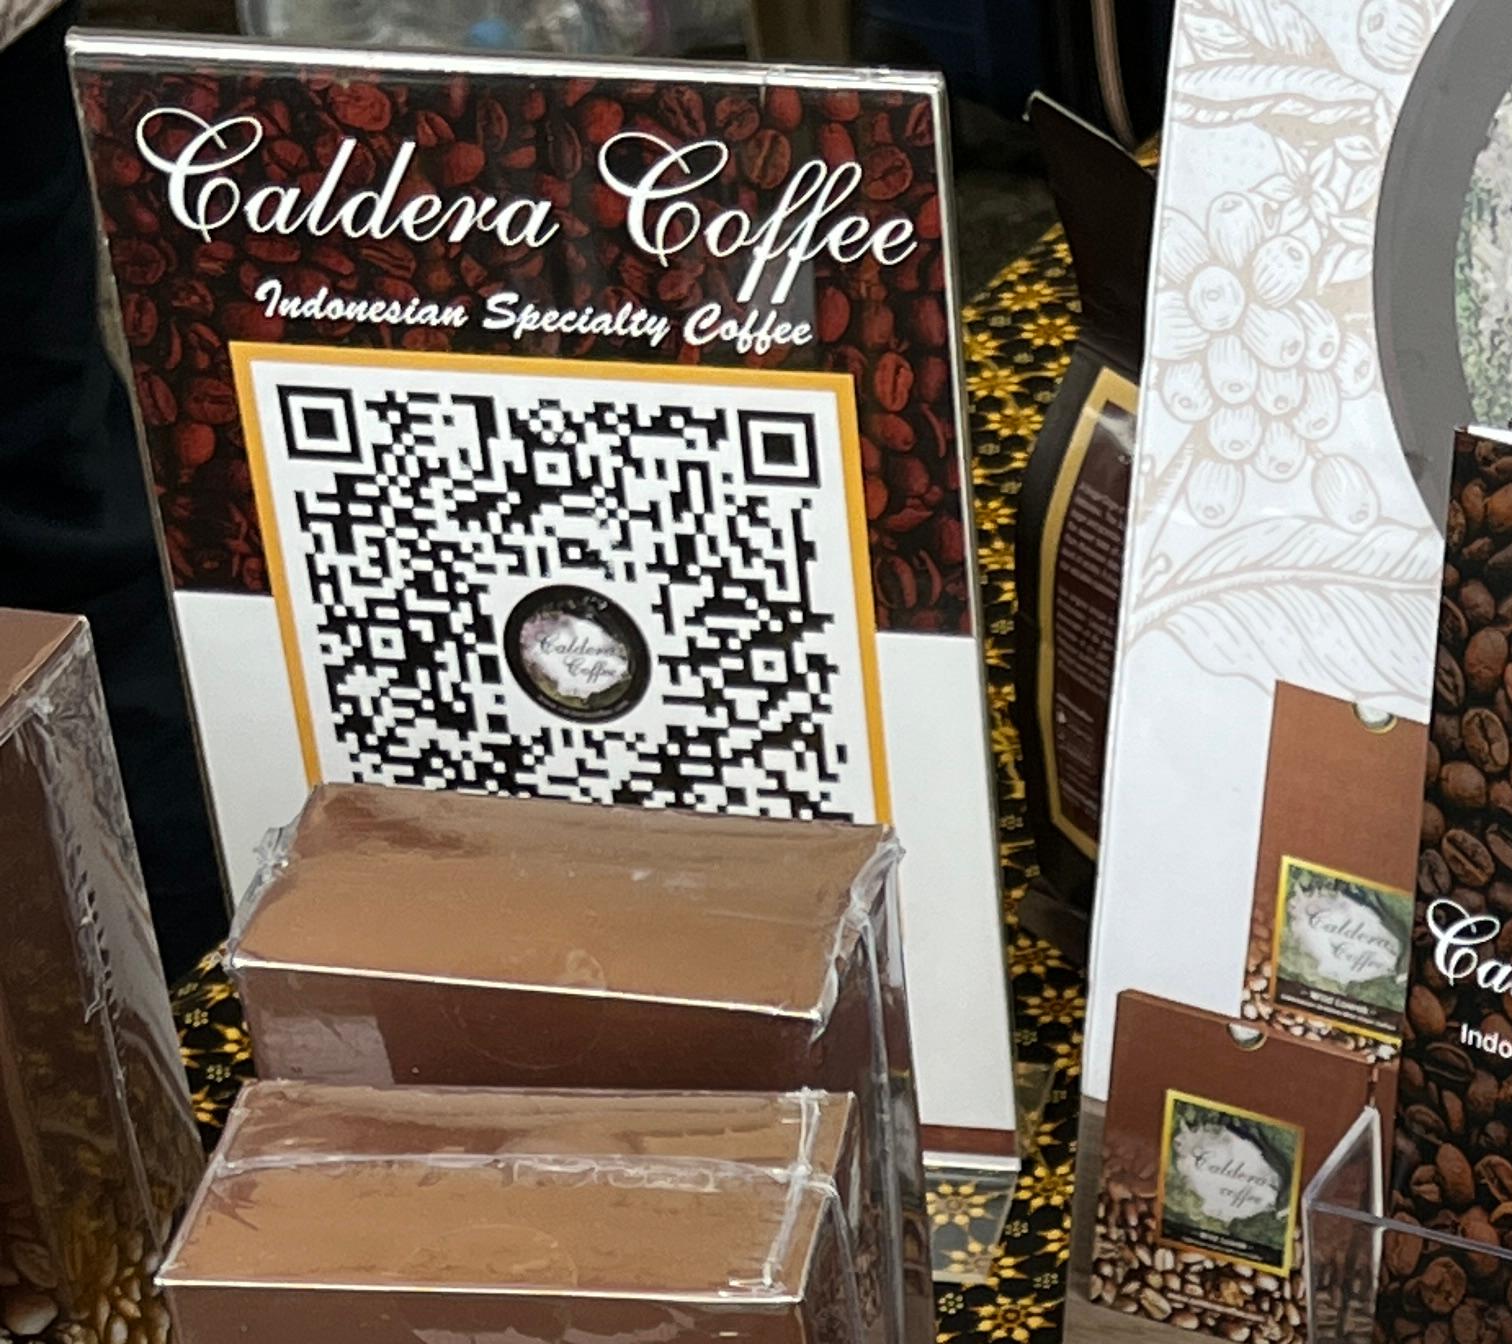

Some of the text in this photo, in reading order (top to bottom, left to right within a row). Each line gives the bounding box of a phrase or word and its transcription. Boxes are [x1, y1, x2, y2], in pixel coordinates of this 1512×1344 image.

[136, 107, 917, 305] Caldera Coffee
[255, 279, 813, 356] Indonesian Specialty Coffee
